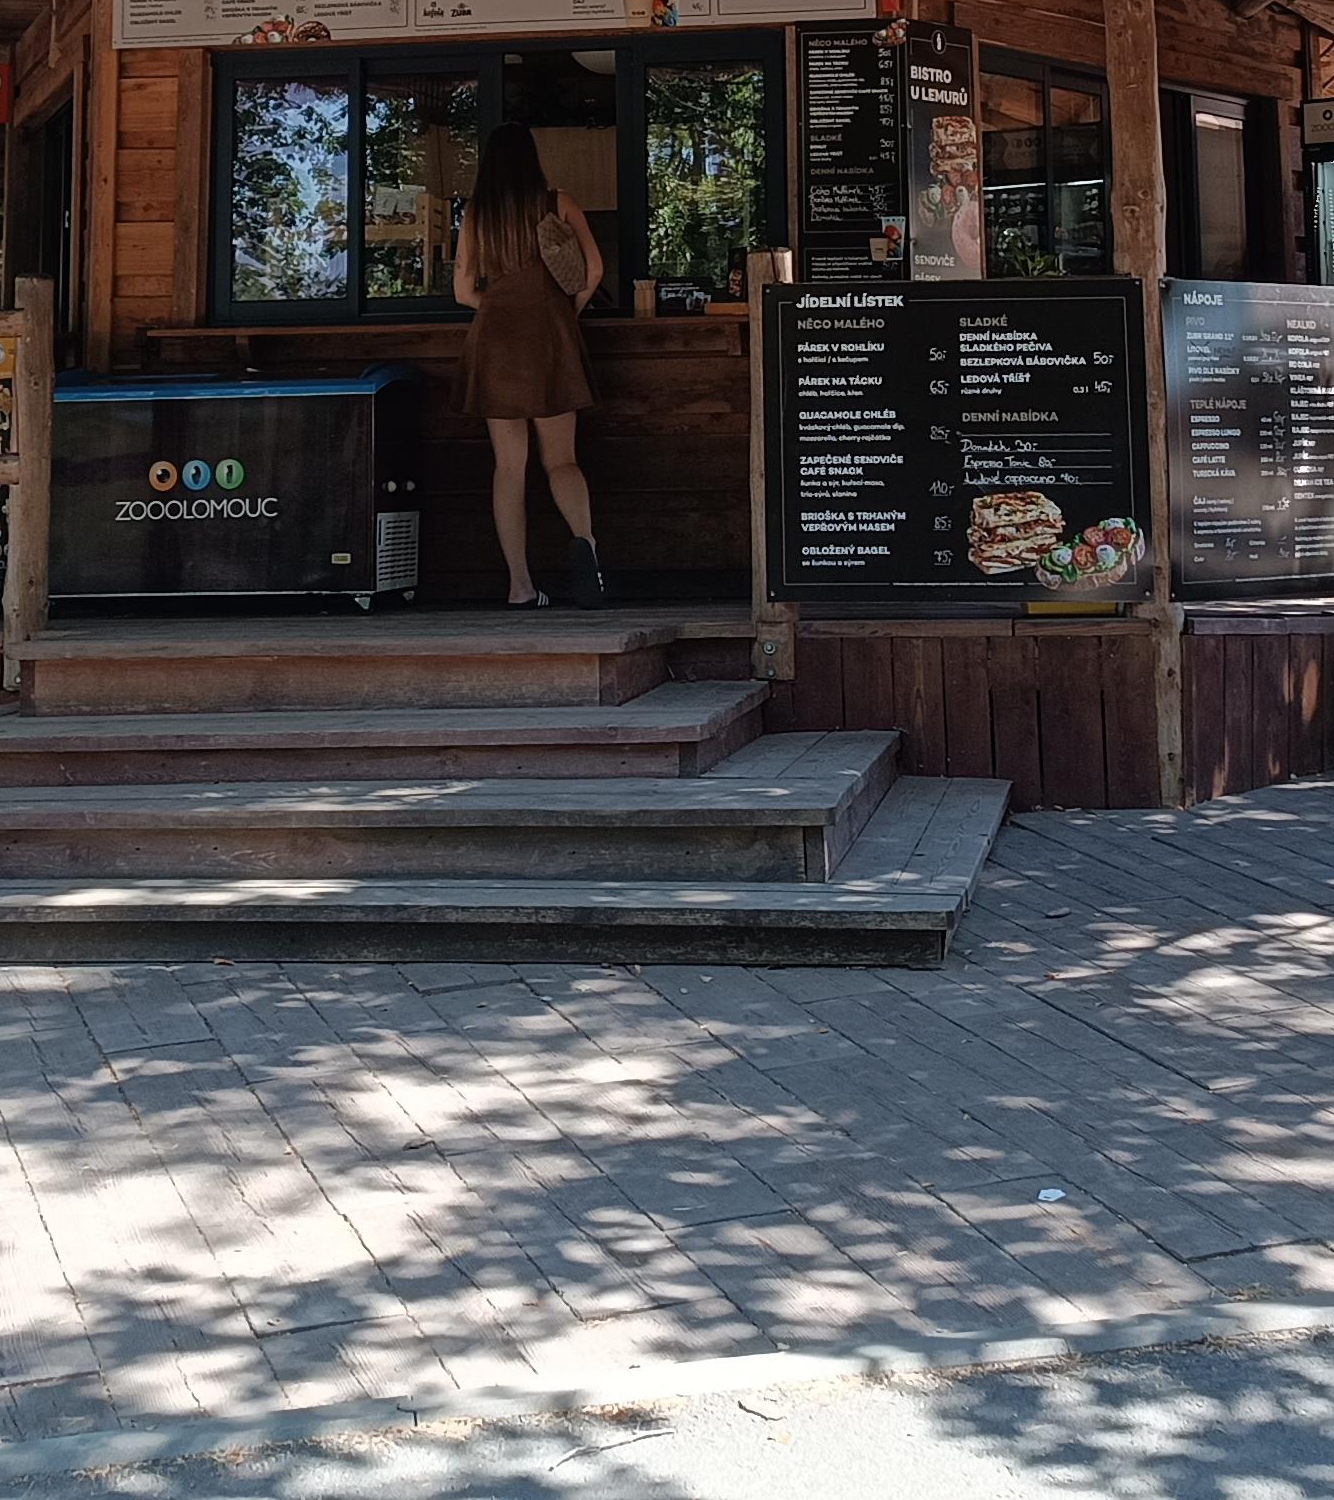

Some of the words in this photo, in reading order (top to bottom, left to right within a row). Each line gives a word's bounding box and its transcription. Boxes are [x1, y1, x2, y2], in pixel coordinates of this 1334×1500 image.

[808, 38, 831, 47] NĚCO
[833, 38, 868, 46] MALÉHO
[910, 65, 952, 84] BISTRO
[910, 86, 919, 100] U
[922, 87, 968, 106] LEMURŮ
[810, 133, 842, 142] SLADKÉ
[810, 166, 835, 175] DENNÍ
[837, 166, 874, 175] NABÍDKA
[914, 254, 955, 267] SENDVIČE
[796, 293, 851, 309] JÍDELNÍ
[853, 293, 904, 308] LÍSTEK
[1183, 290, 1223, 306] NÁPOJE
[798, 317, 832, 330] NĚCO
[834, 317, 885, 329] MALÉHO
[959, 313, 1008, 327] SLADKÉ
[1185, 316, 1205, 326] PIVO
[1287, 319, 1316, 330] NEALKO
[960, 330, 990, 342] DENNÍ
[992, 330, 1038, 341] NABÍDKA
[798, 342, 829, 353] PÁREK
[831, 344, 839, 352] V
[841, 340, 885, 352] ROHLÍKU
[960, 342, 1014, 352] SLADKÉHO
[1016, 342, 1053, 351] PEČIVA
[960, 355, 1024, 366] BEZLEPKOVÁ
[1025, 355, 1086, 366] BÁBOVIČKA
[798, 375, 830, 387] PÁREK
[832, 377, 847, 386] NA
[848, 375, 883, 386] TÁCKU
[961, 372, 1000, 383] LEDOVÁ
[1190, 397, 1214, 410] TEPLÉ
[1215, 397, 1247, 410] NÁPOJE
[863, 408, 896, 419] CHLÉB
[962, 409, 999, 422] DENNÍ
[1002, 409, 1059, 422] NABÍDKA
[800, 454, 852, 465] ZAPEČENÉ
[854, 453, 903, 464] SENDVIČE
[800, 465, 826, 476] CAFÉ
[828, 467, 863, 476] SNACK
[115, 497, 278, 521] ZOOOLOMOUC
[801, 510, 845, 521] BRIOŠKA
[847, 512, 855, 521] S
[856, 510, 906, 521] TRHANÝM
[801, 521, 857, 532] VEPŘOVÝM
[859, 523, 895, 532] MASEM
[802, 544, 855, 555] OBLOŽENÝ
[857, 546, 890, 555] BAGEL
